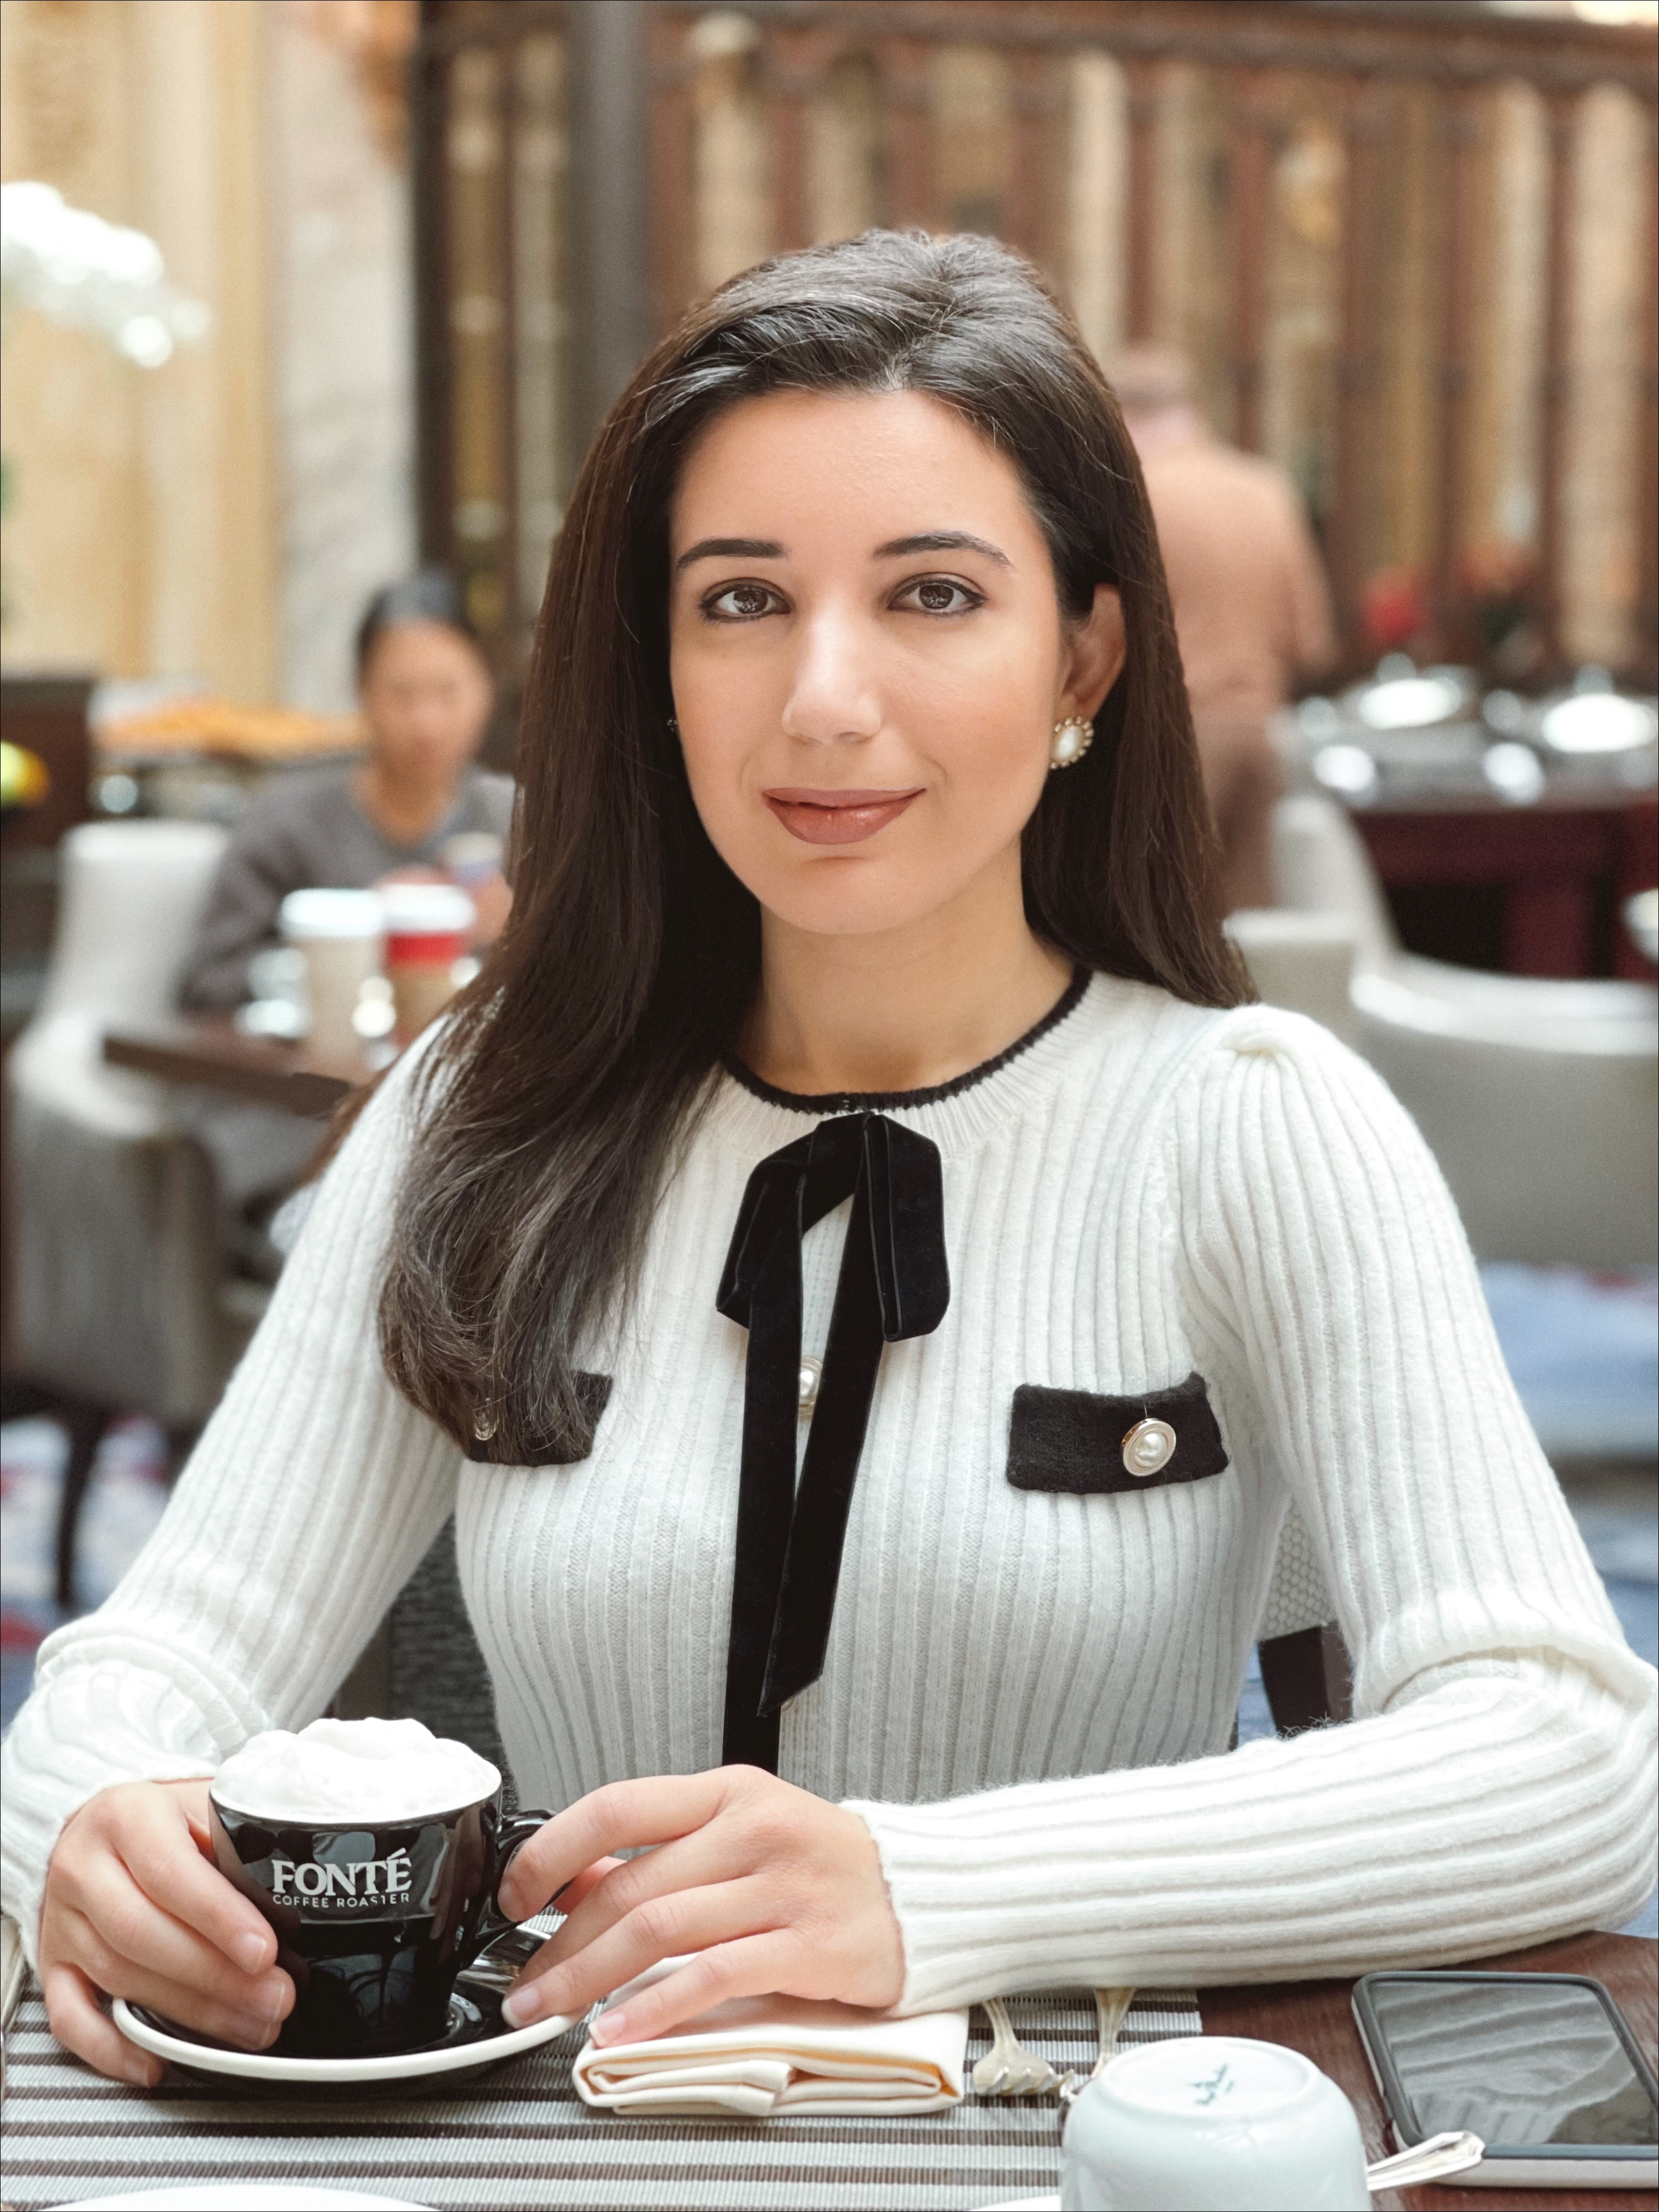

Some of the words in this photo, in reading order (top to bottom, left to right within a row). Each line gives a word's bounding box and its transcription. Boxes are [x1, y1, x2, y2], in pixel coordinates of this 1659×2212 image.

[272, 1848, 411, 1896] FONTÉ
[273, 1895, 329, 1908] COFFEE
[336, 1893, 409, 1908] ROASTER
